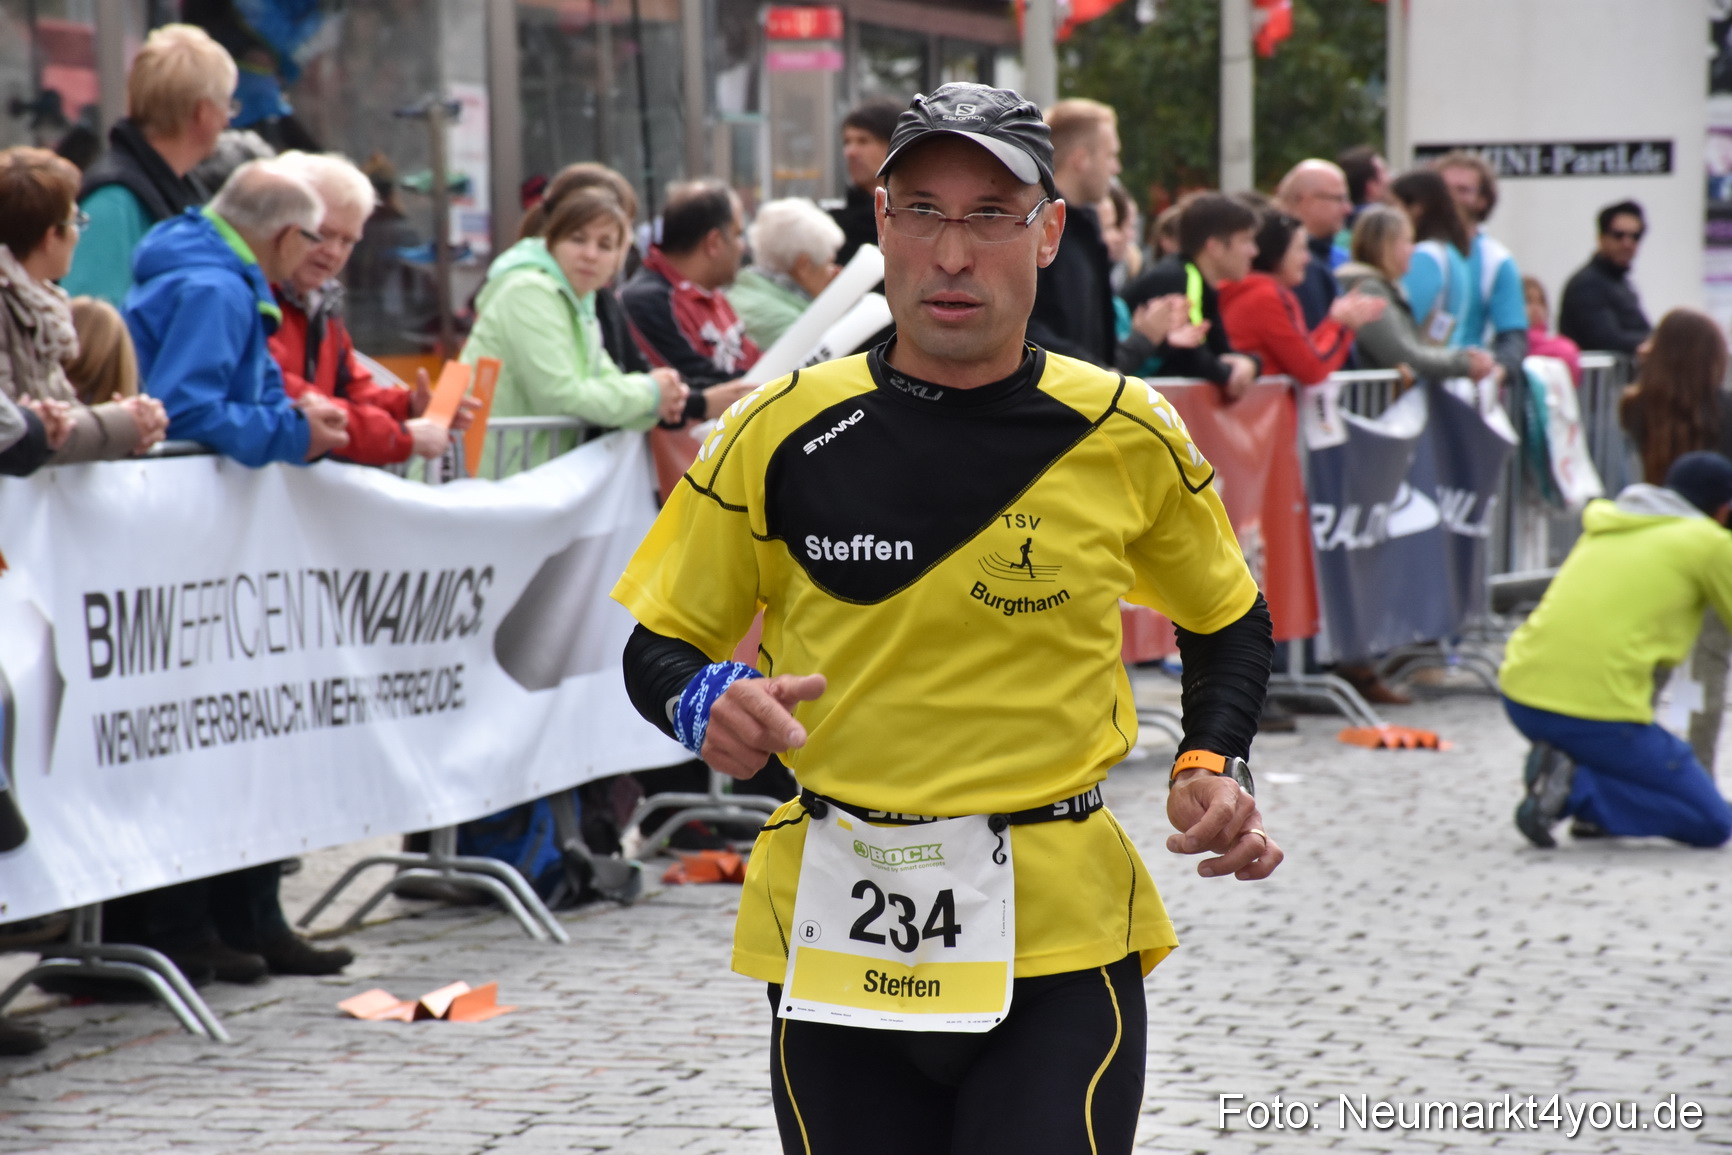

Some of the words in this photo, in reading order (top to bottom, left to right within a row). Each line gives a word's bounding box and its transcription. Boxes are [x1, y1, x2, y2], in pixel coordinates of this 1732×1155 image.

[802, 408, 865, 455] STANNO
[1001, 513, 1042, 531] TSV
[804, 534, 914, 561] Steffen
[969, 580, 1071, 616] Burgthann
[92, 702, 181, 768] WENIGER
[868, 843, 944, 866] BOCK
[849, 879, 962, 953] 234
[805, 925, 814, 938] B
[863, 969, 941, 998] Steffen
